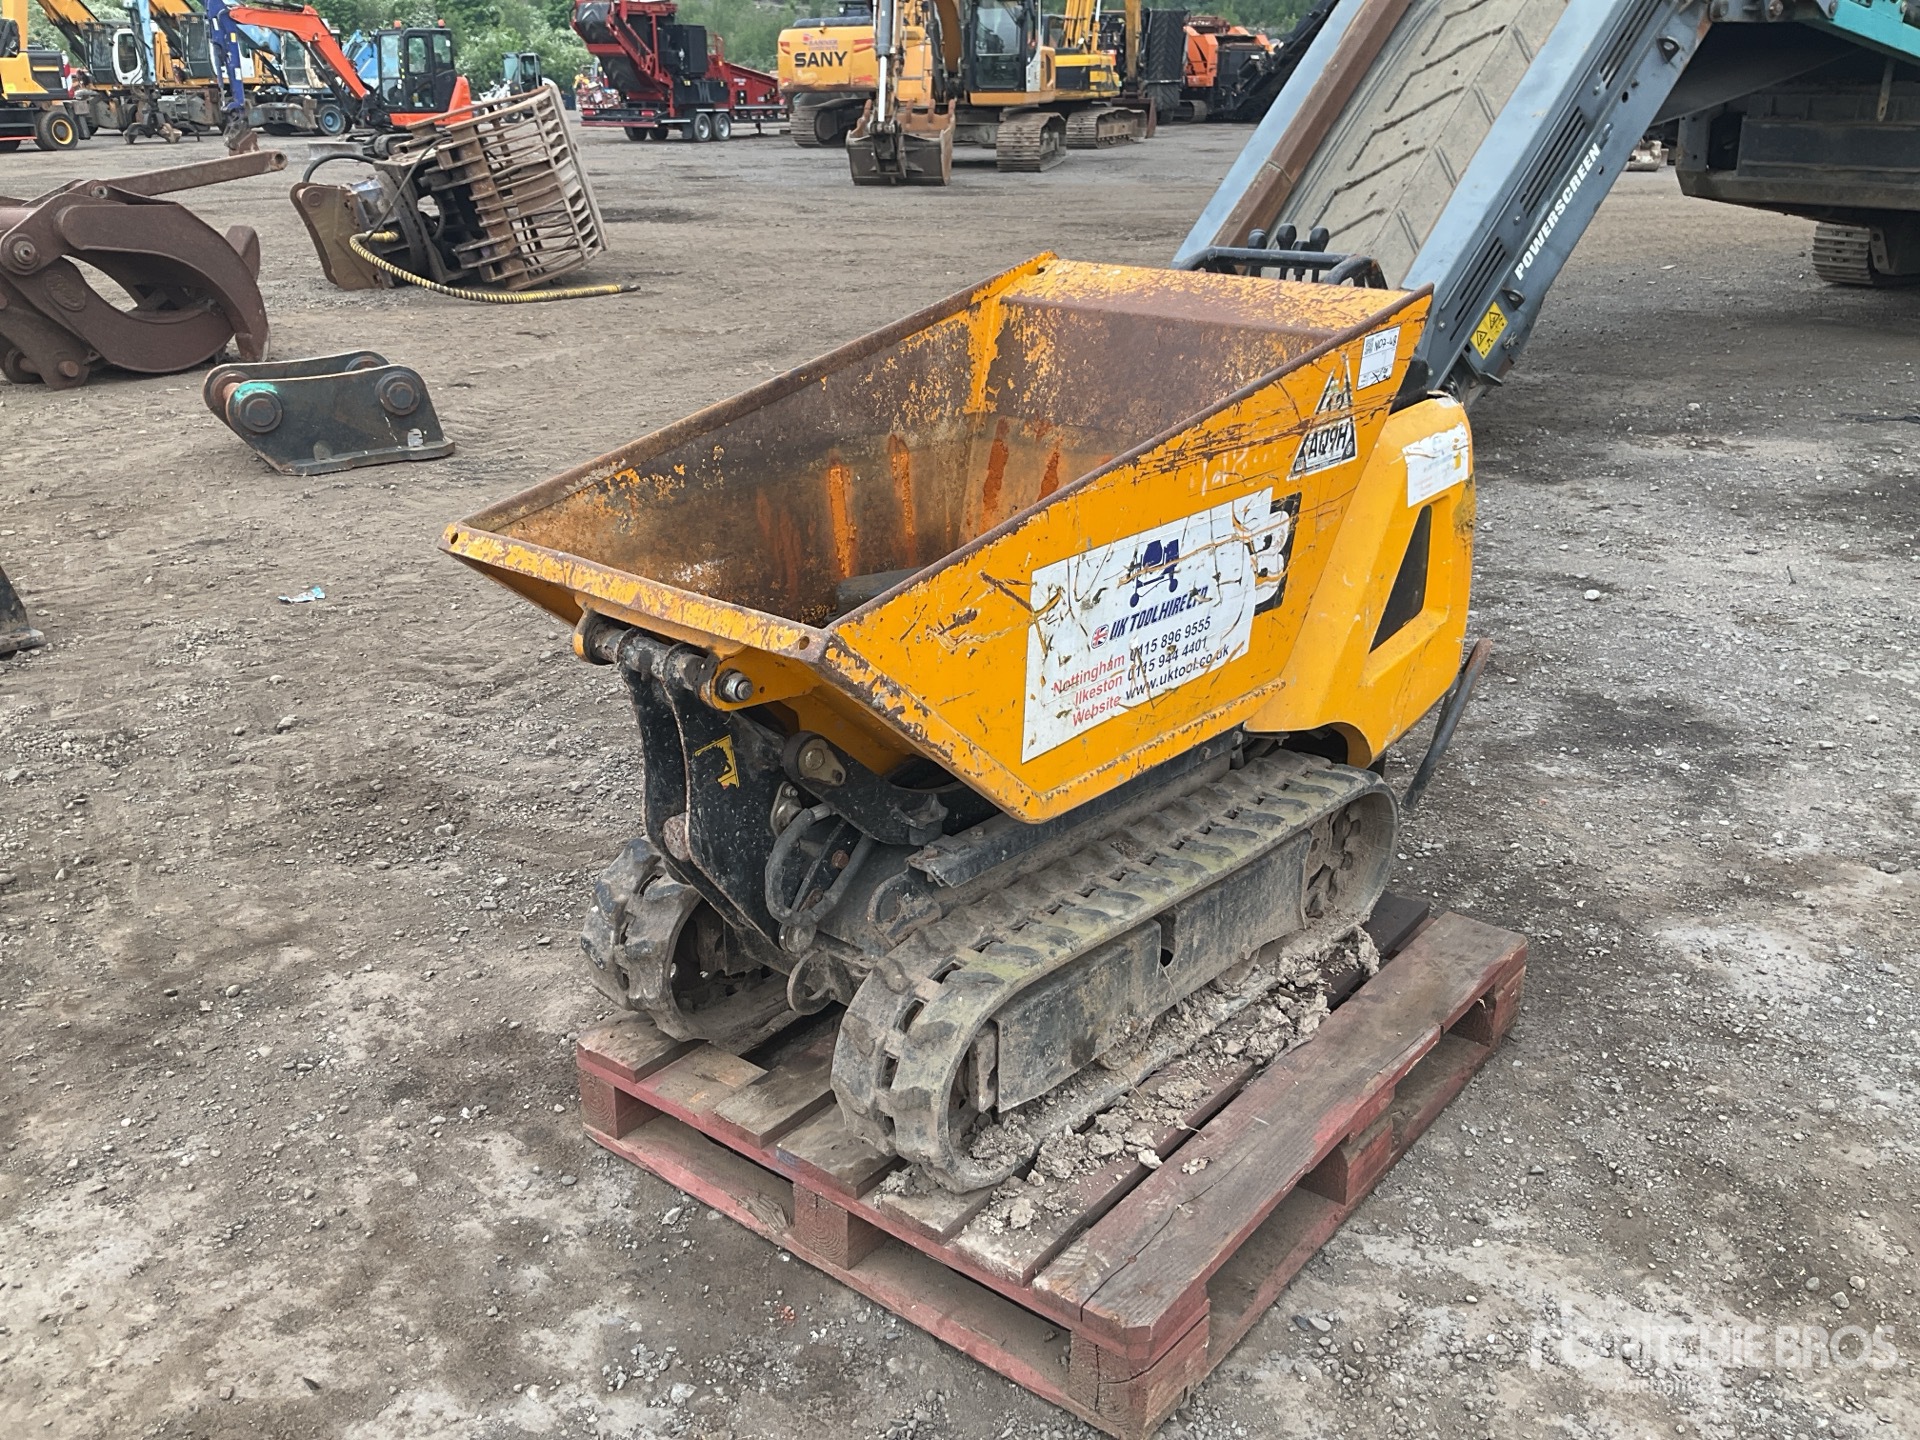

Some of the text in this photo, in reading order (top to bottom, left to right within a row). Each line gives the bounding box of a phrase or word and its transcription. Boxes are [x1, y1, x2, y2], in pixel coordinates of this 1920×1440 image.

[794, 51, 848, 68] SANY
[1514, 142, 1601, 281] POWERSCREEN
[1052, 654, 1125, 694] Nottingham
[1161, 629, 1182, 648] 896
[1184, 616, 1211, 640] 9555
[1109, 616, 1130, 641] UK
[1072, 644, 1229, 727] Website www.uktool.couk
[1074, 636, 1208, 707] Ilkeston 0115 944 4401
